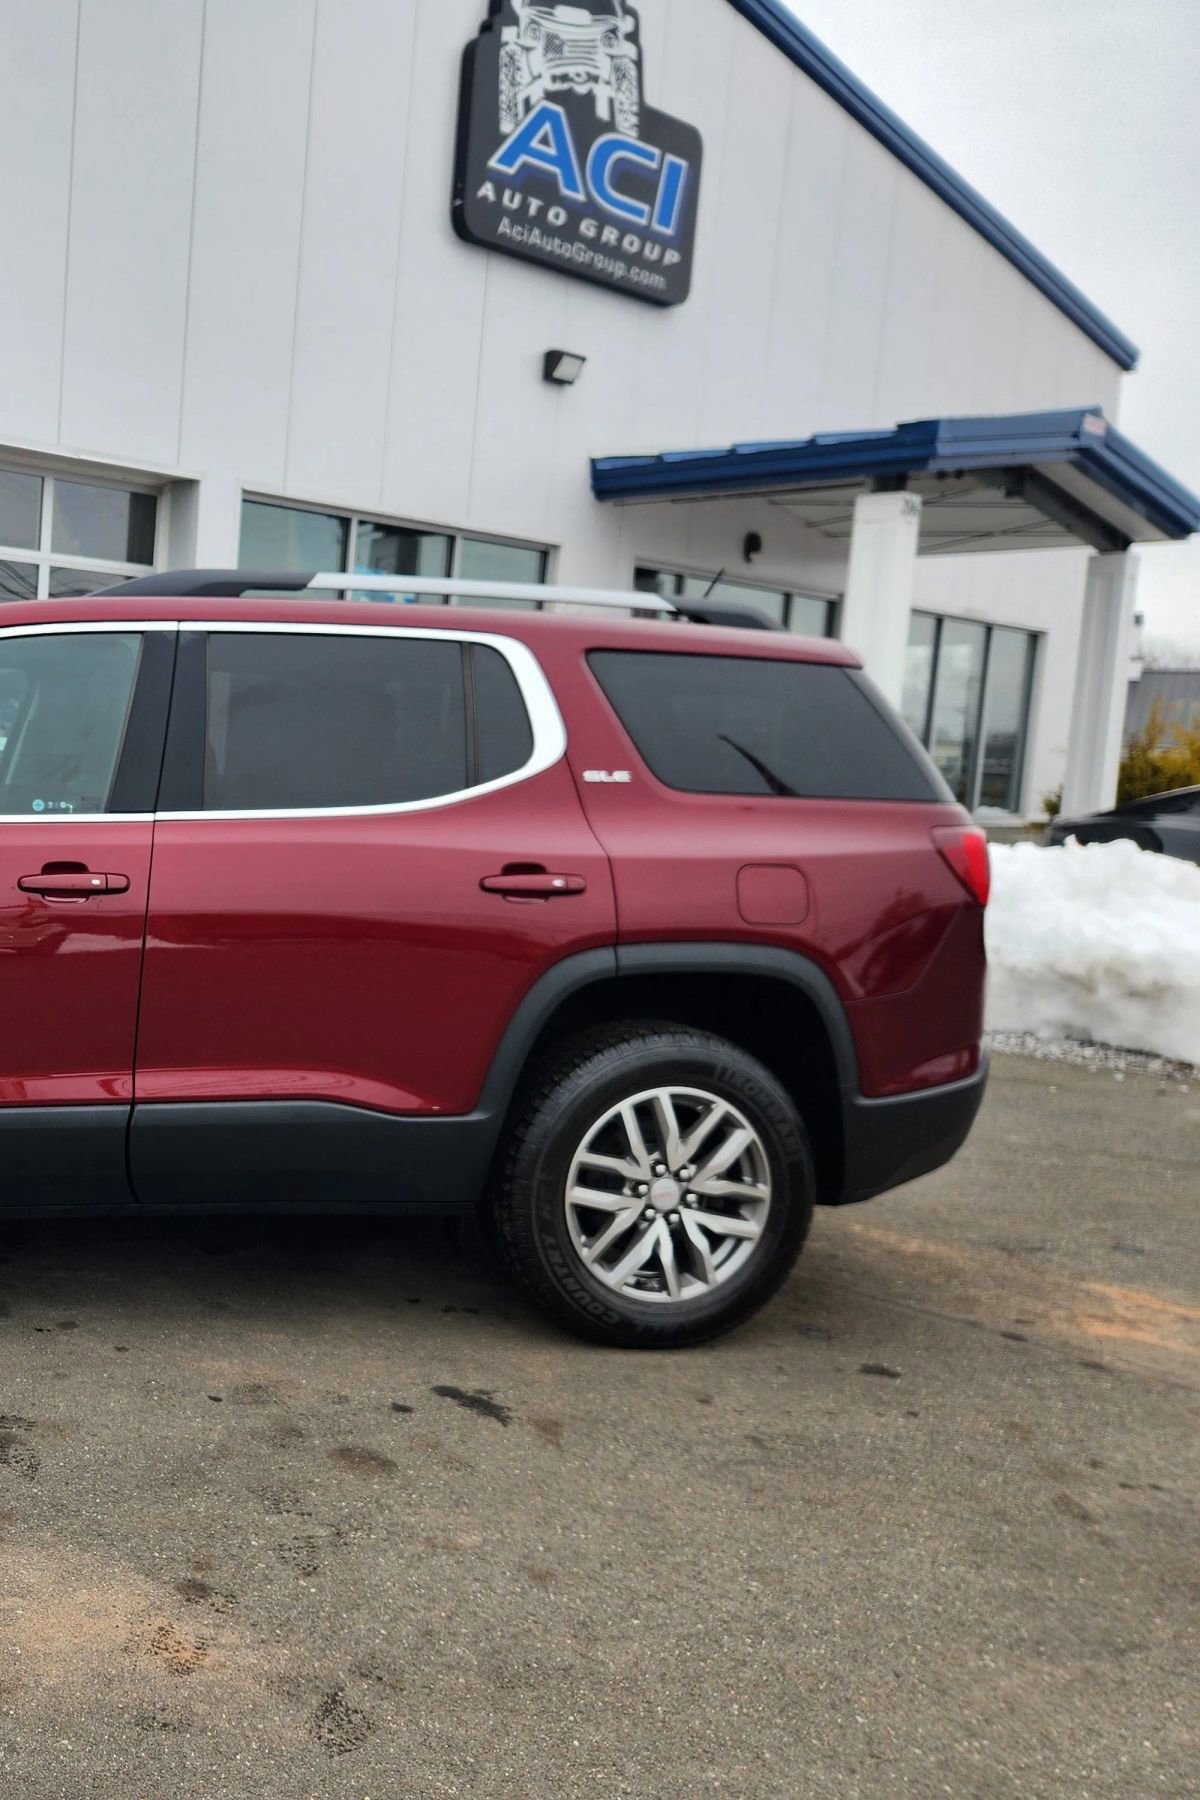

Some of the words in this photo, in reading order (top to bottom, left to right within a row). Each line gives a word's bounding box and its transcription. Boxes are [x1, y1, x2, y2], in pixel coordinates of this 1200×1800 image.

[486, 99, 689, 236] ACI
[476, 181, 568, 227] AUTO
[579, 217, 682, 267] GROUP
[497, 215, 667, 290] AciAutoGroup.com
[582, 769, 633, 783] SLE
